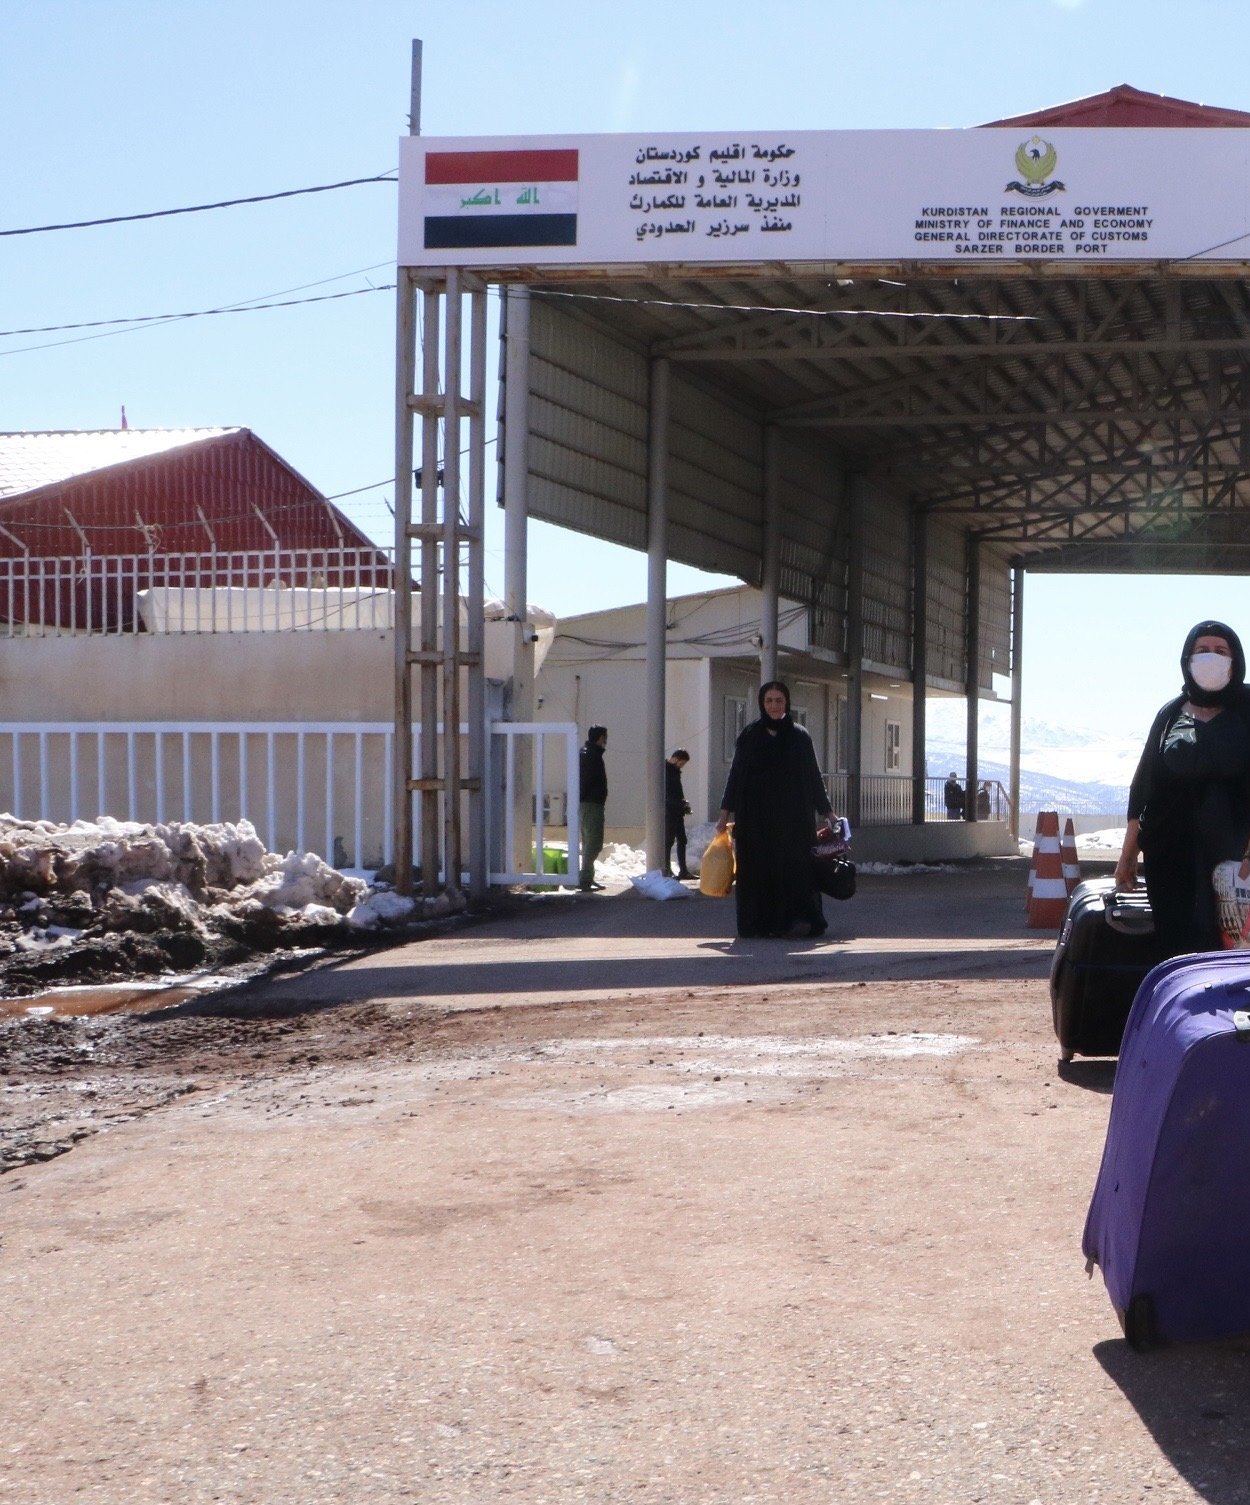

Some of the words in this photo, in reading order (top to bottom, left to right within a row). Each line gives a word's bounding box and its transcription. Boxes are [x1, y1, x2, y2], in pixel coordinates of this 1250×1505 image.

[635, 145, 700, 164] كوردستان
[751, 143, 796, 163] حكومة
[628, 168, 688, 185] الاقتصاد
[697, 174, 705, 188] و
[712, 169, 756, 188] المالية
[762, 168, 801, 188] وزارة
[629, 193, 686, 212] للكمارك
[694, 193, 738, 209] العامة
[745, 193, 801, 212] المديرية
[921, 207, 988, 217] KURDISTAN
[1001, 207, 1061, 217] REGIONAL
[1074, 206, 1149, 216] GOVERMENT
[636, 220, 696, 241] الحدودي
[706, 219, 750, 238] سرزير
[760, 215, 793, 232] منفذ
[915, 219, 970, 229] MINISTRY
[977, 219, 993, 229] OF
[1000, 219, 1050, 229] FINANCE
[1060, 219, 1085, 229] AND
[1094, 219, 1153, 229] ECONOMY
[914, 232, 971, 242] GENERAL
[978, 232, 1063, 242] DIRECTORATE
[1070, 232, 1086, 242] OF
[1091, 231, 1148, 241] CUSTOMS
[955, 244, 1003, 254] SARZER
[1015, 244, 1065, 254] BORDER
[1075, 244, 1108, 254] PORT
